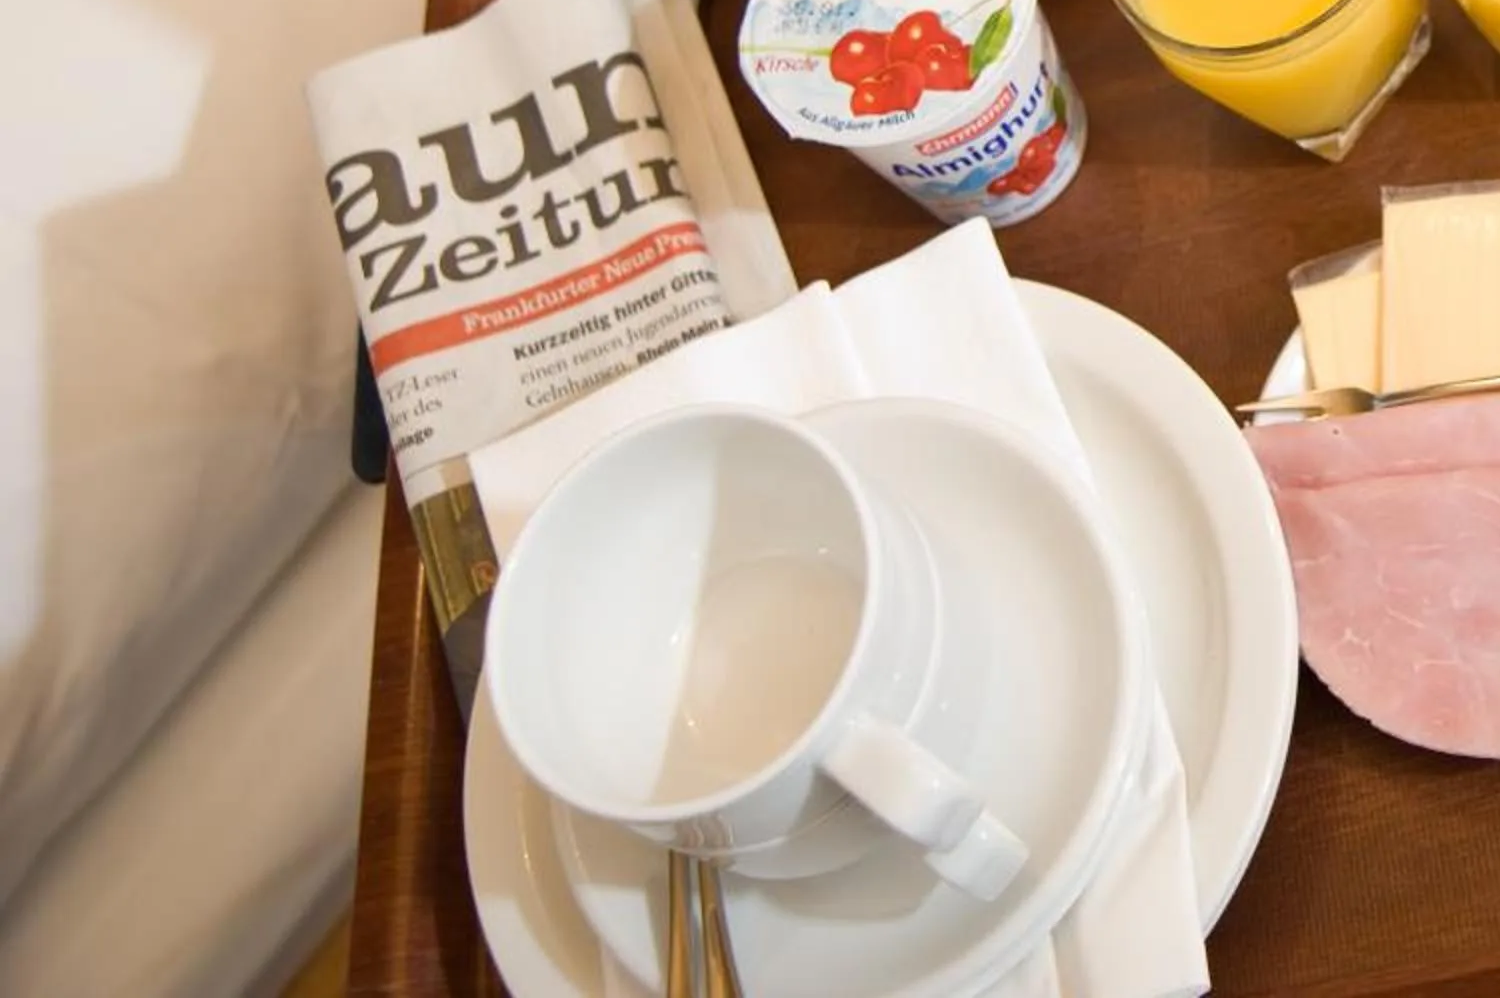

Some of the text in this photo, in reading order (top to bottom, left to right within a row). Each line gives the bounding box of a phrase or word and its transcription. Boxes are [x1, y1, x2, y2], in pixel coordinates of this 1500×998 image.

[893, 60, 1052, 182] Almighurt
[460, 274, 601, 336] Frankfurter
[602, 245, 656, 284] Neue
[512, 314, 613, 362] Kurzzeitig
[613, 284, 668, 321] hinter
[519, 356, 570, 386] einen
[572, 337, 625, 368] neuen
[411, 395, 443, 418] des
